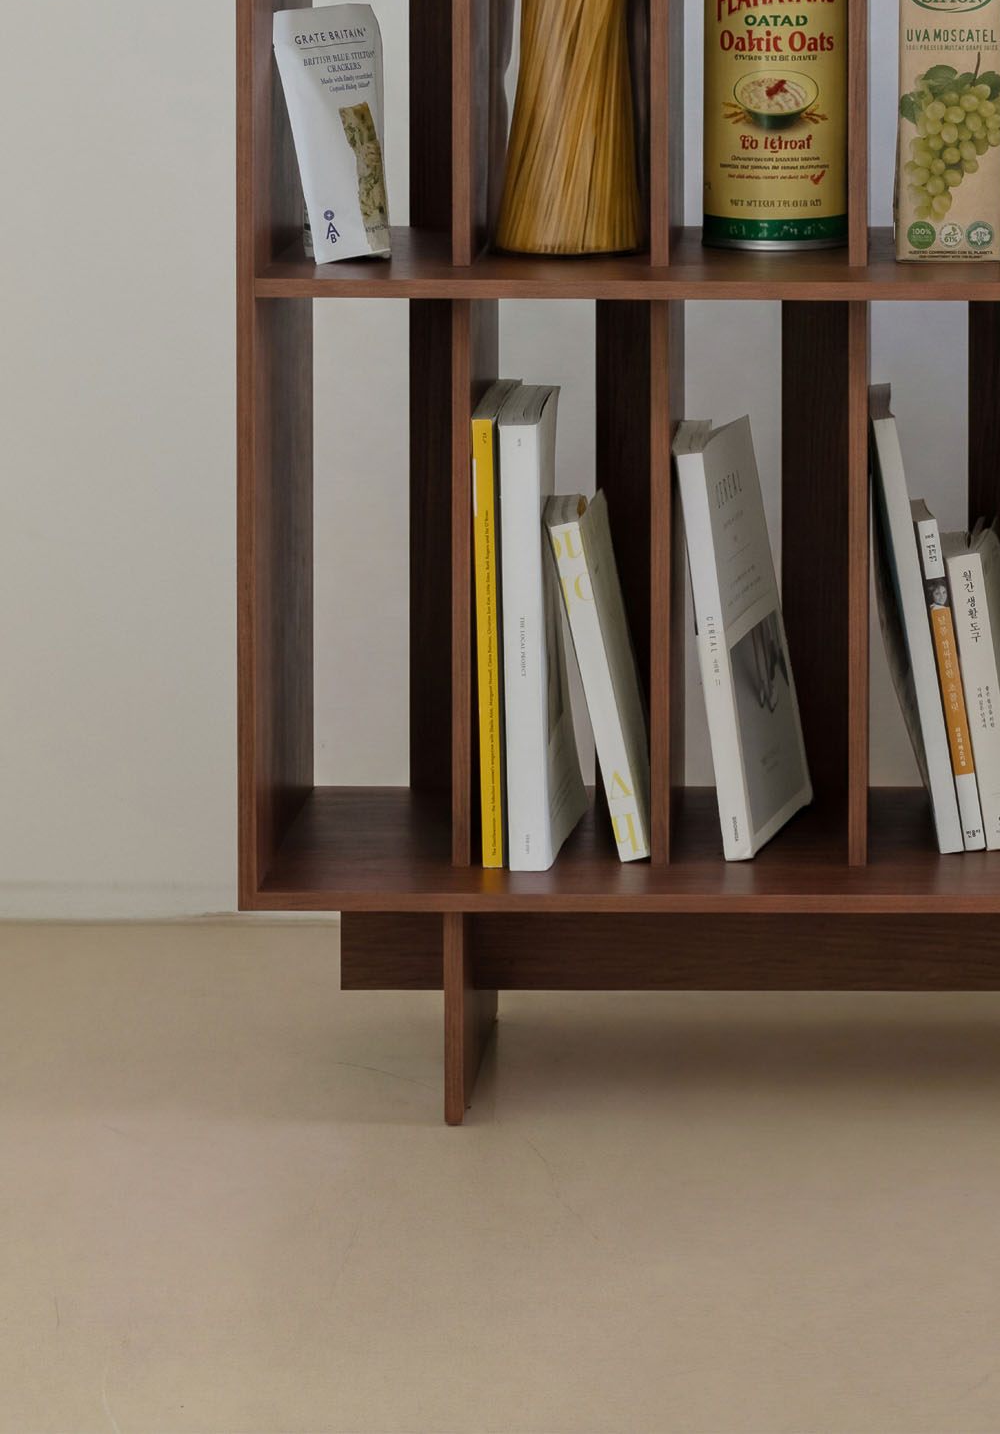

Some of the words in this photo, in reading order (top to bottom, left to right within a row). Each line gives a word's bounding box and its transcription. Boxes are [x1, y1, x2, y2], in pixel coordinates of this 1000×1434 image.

[744, 14, 808, 26] OATAD
[294, 32, 326, 45] GRATE
[788, 31, 834, 52] Oats
[906, 29, 930, 42] UVA
[933, 28, 997, 43] MOSCATEL
[303, 55, 331, 67] BRITISH
[332, 52, 350, 63] BLUE
[327, 62, 362, 73] CRACKERS
[962, 570, 974, 593] 월간
[966, 595, 978, 619] 생활
[970, 622, 981, 643] 도구
